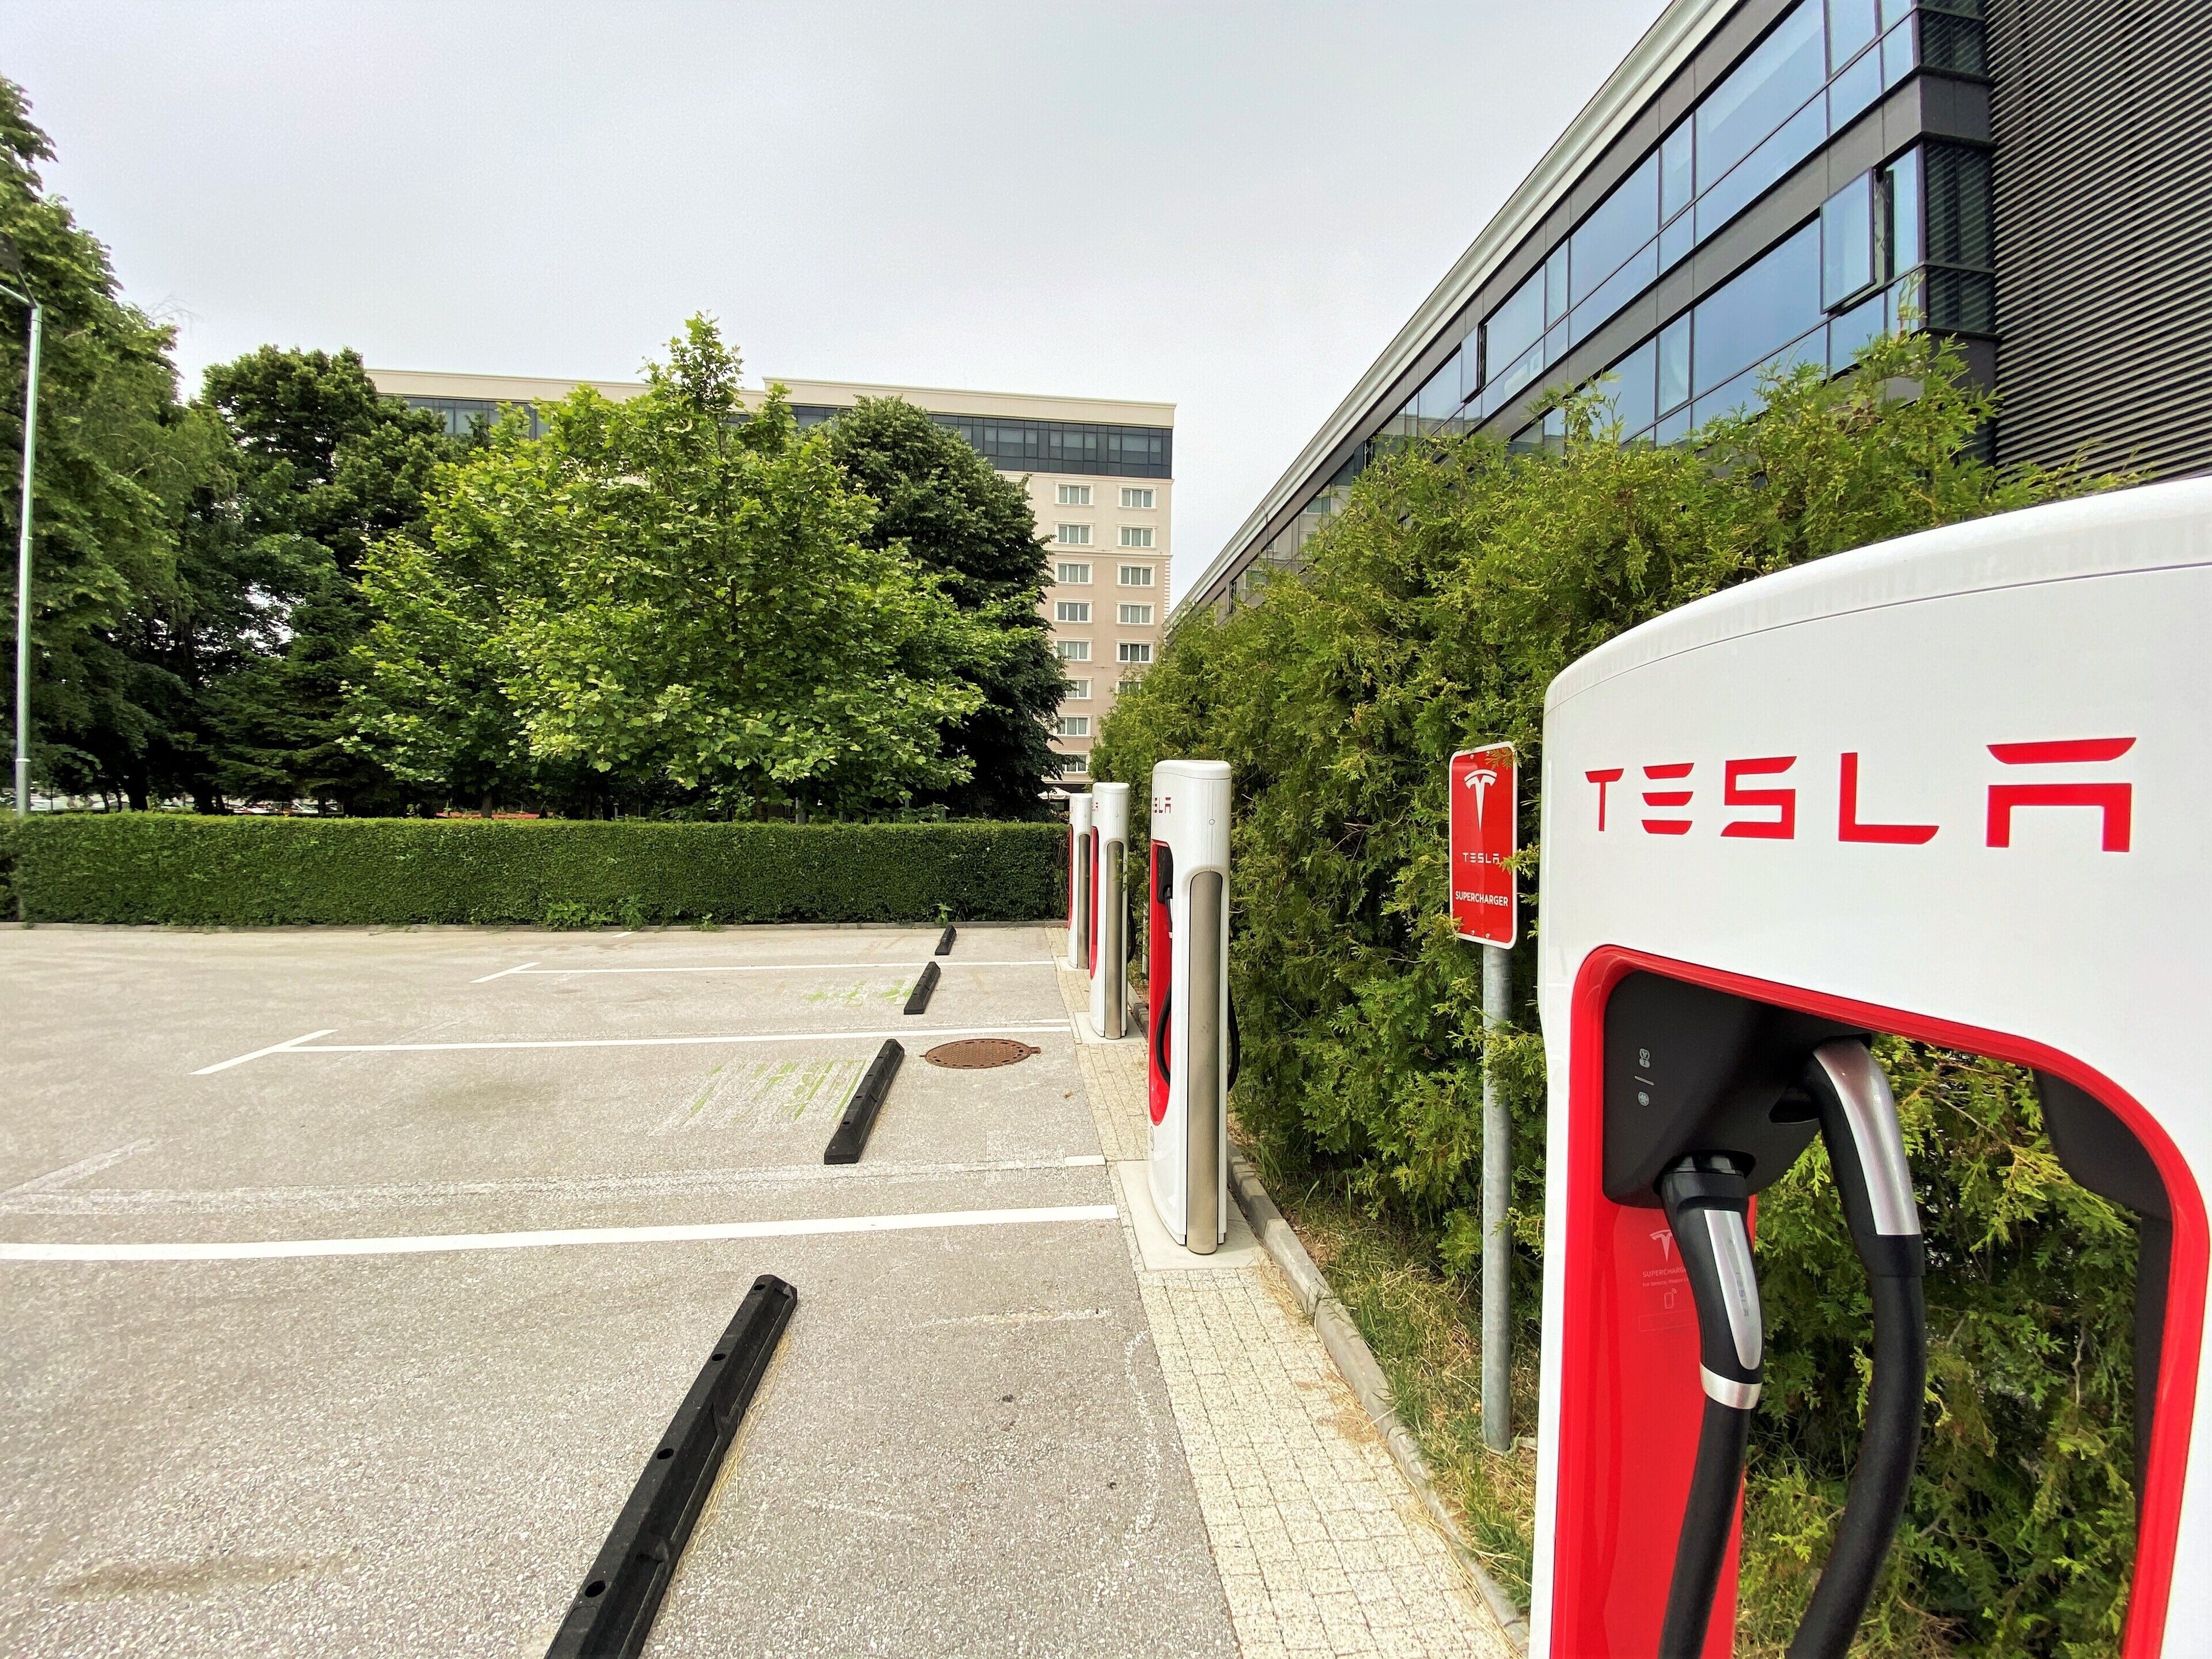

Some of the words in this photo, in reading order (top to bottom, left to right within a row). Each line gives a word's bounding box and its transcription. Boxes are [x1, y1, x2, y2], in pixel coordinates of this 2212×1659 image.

[1585, 737, 2136, 853] TESLA
[1462, 853, 1500, 865] TESLA
[1455, 891, 1509, 907] SUPERCHARGER
[1642, 1267, 1686, 1278] SUPERCHARG
